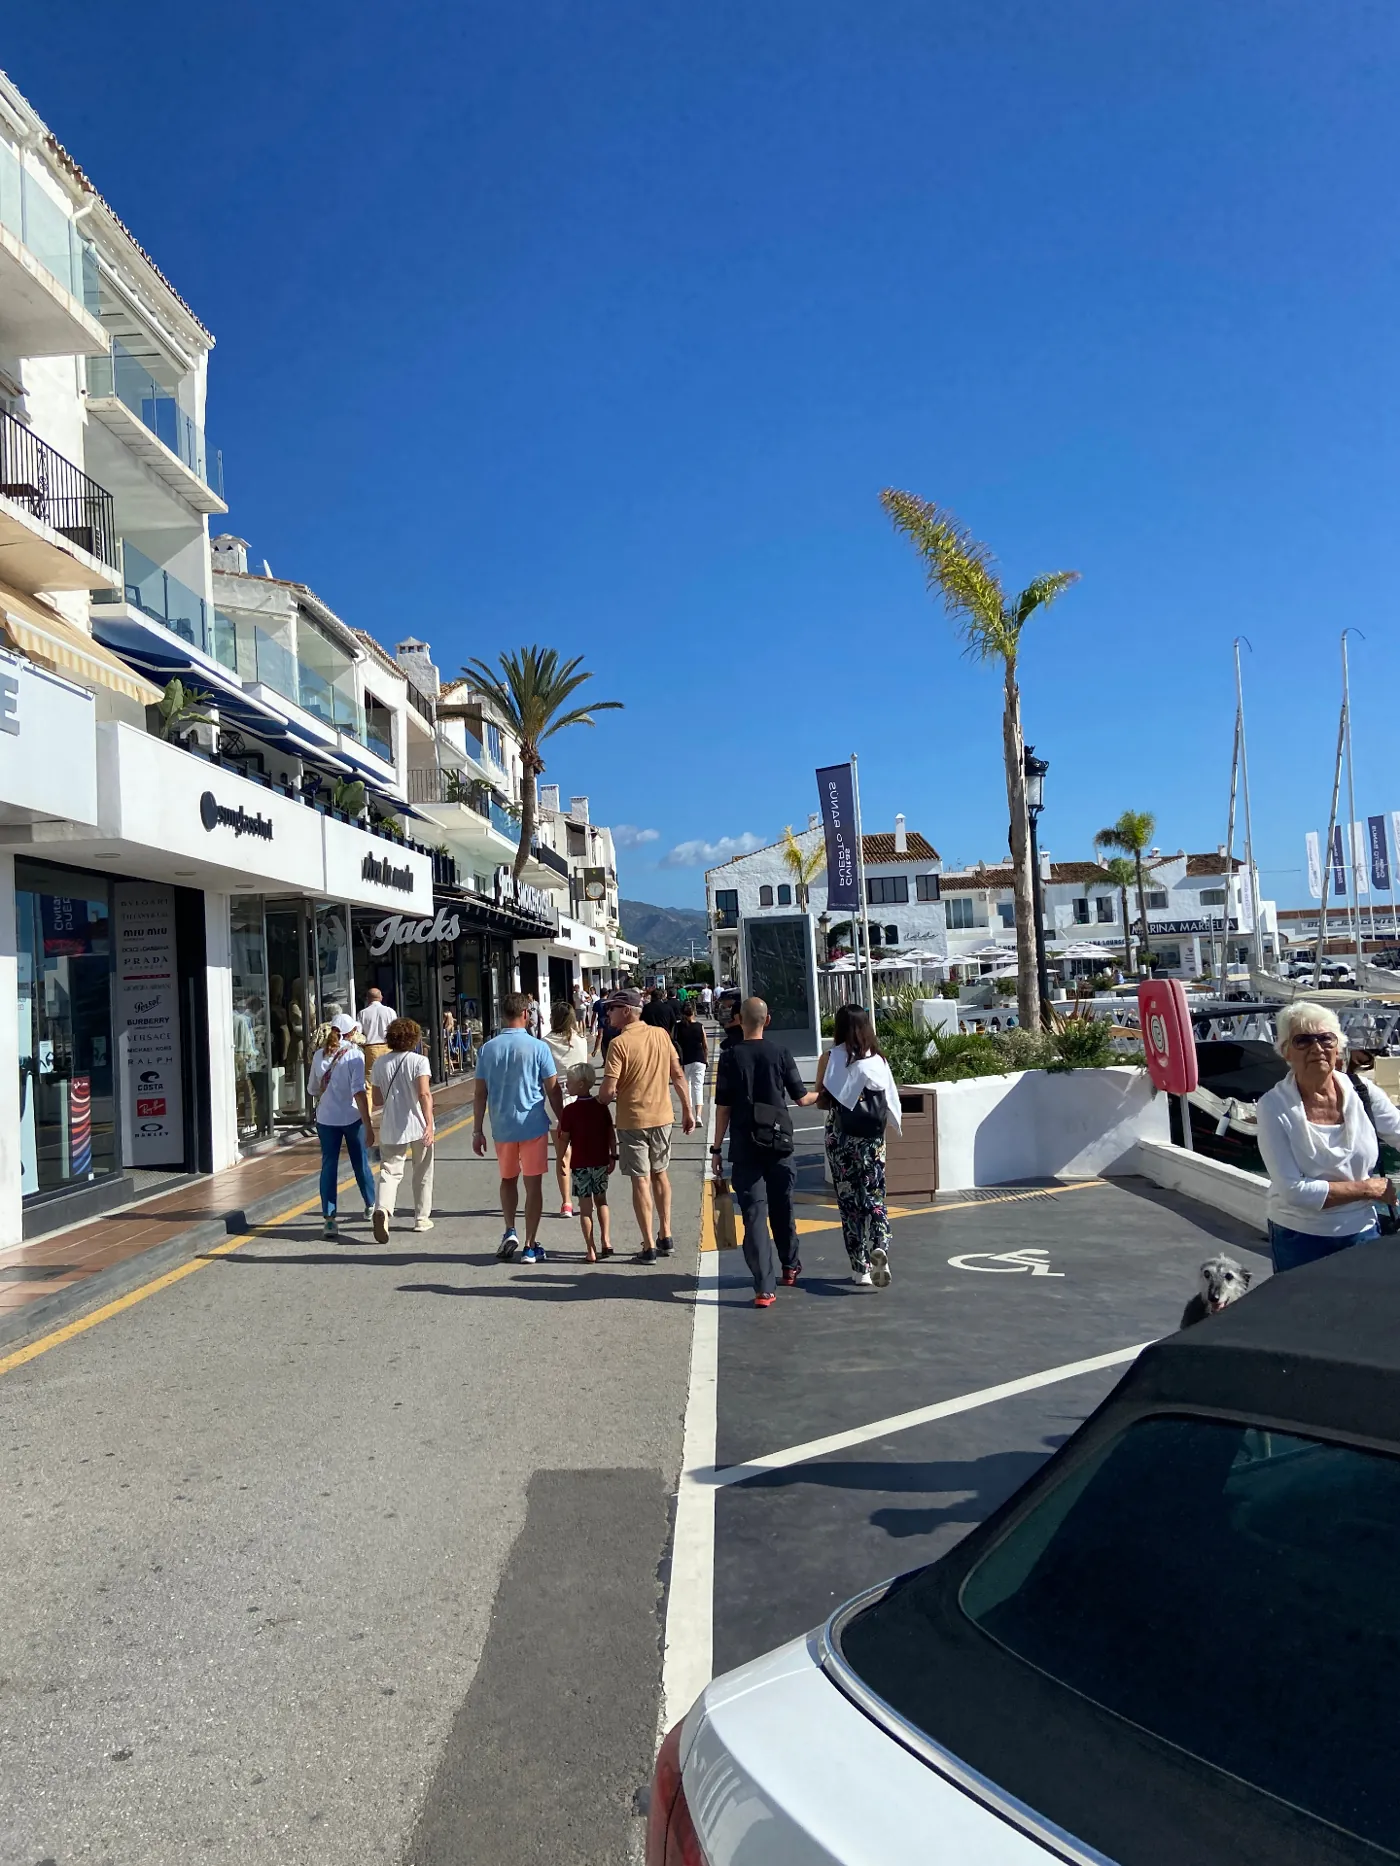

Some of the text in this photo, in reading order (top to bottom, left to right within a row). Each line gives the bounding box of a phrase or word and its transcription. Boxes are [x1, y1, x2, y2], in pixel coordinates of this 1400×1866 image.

[1131, 922, 1176, 935] MRINA
[1307, 920, 1334, 928] BLE
[370, 907, 461, 956] Jacks
[124, 956, 169, 965] PRADA
[127, 1017, 170, 1026] BURBERRY
[127, 1033, 172, 1042] VERSACE
[128, 1057, 173, 1066] RALPH
[138, 1083, 164, 1092] COSTA
